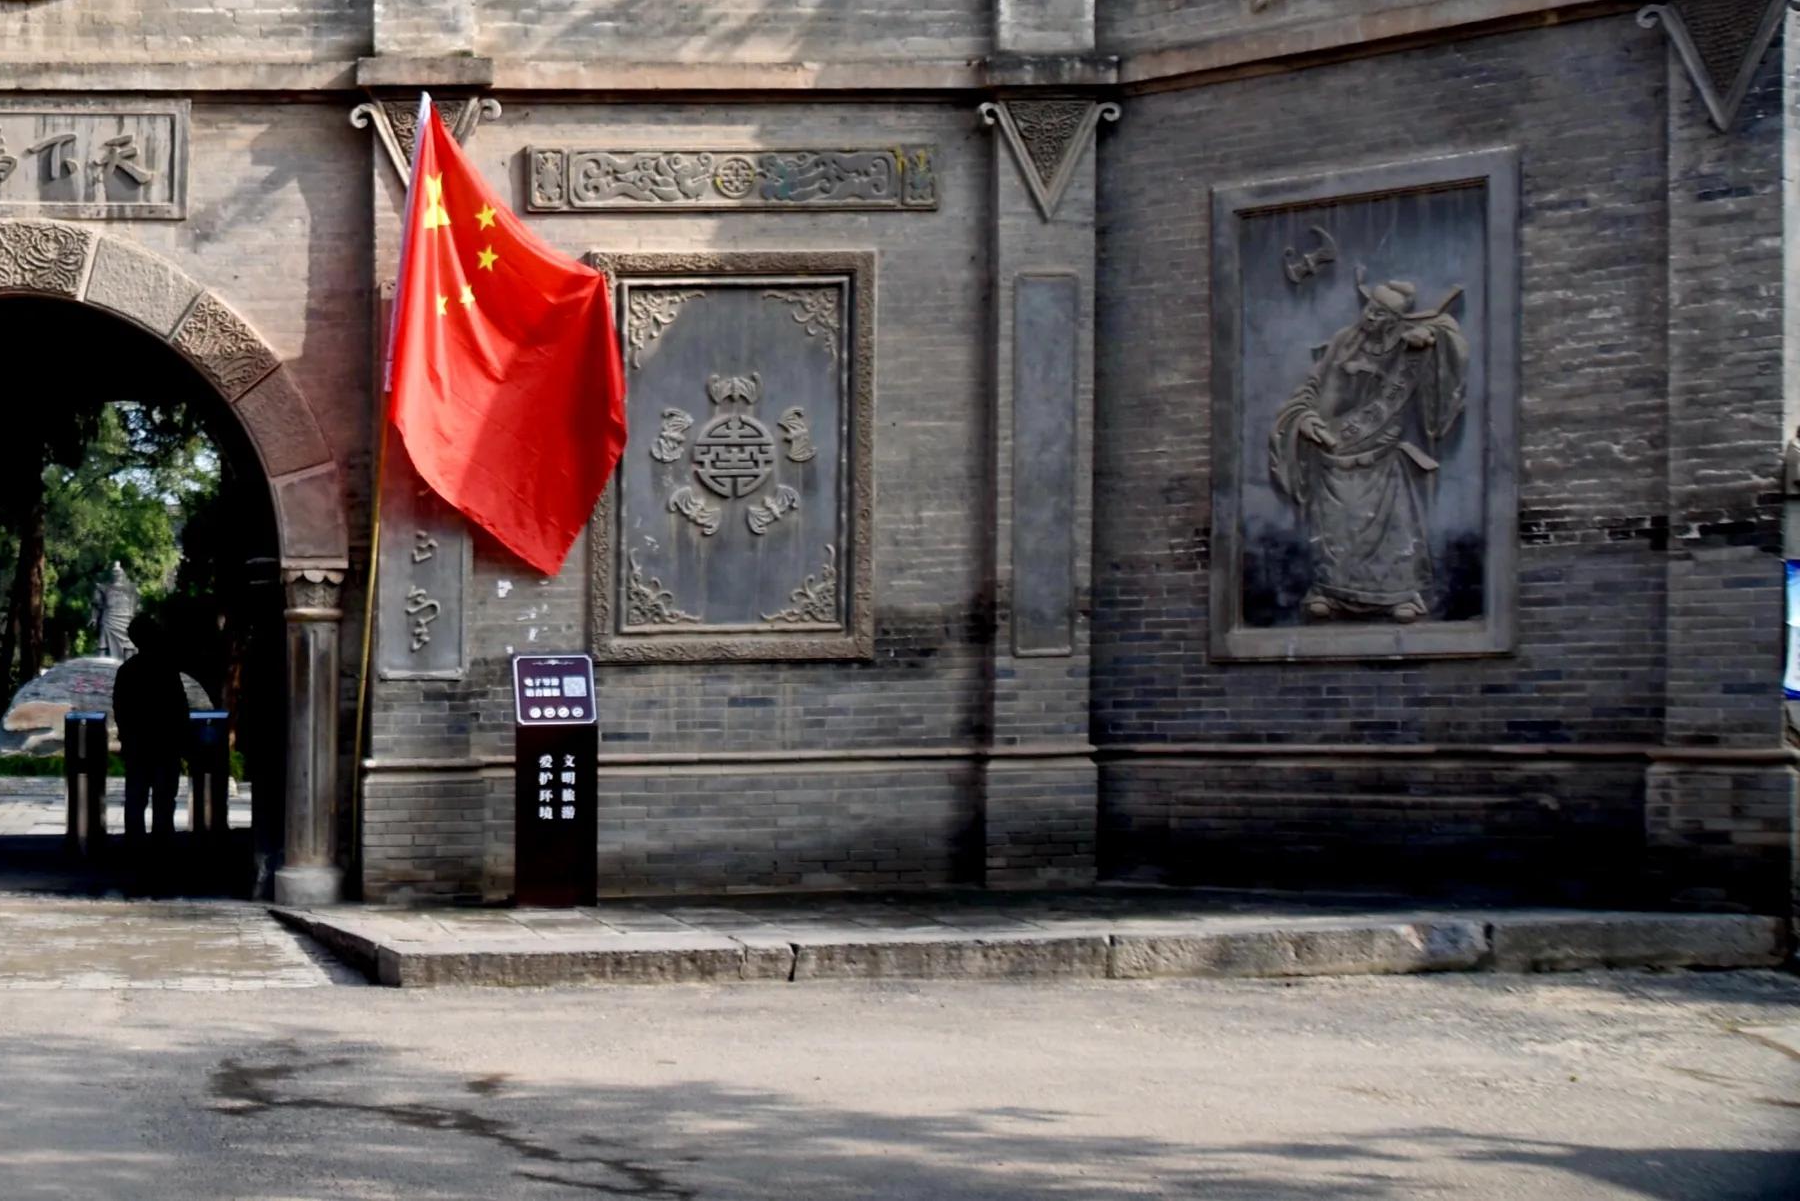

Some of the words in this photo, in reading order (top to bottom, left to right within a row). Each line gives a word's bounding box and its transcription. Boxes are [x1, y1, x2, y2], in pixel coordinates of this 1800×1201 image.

[539, 753, 553, 820] 爱护环境
[561, 753, 576, 820] 文明旅游
